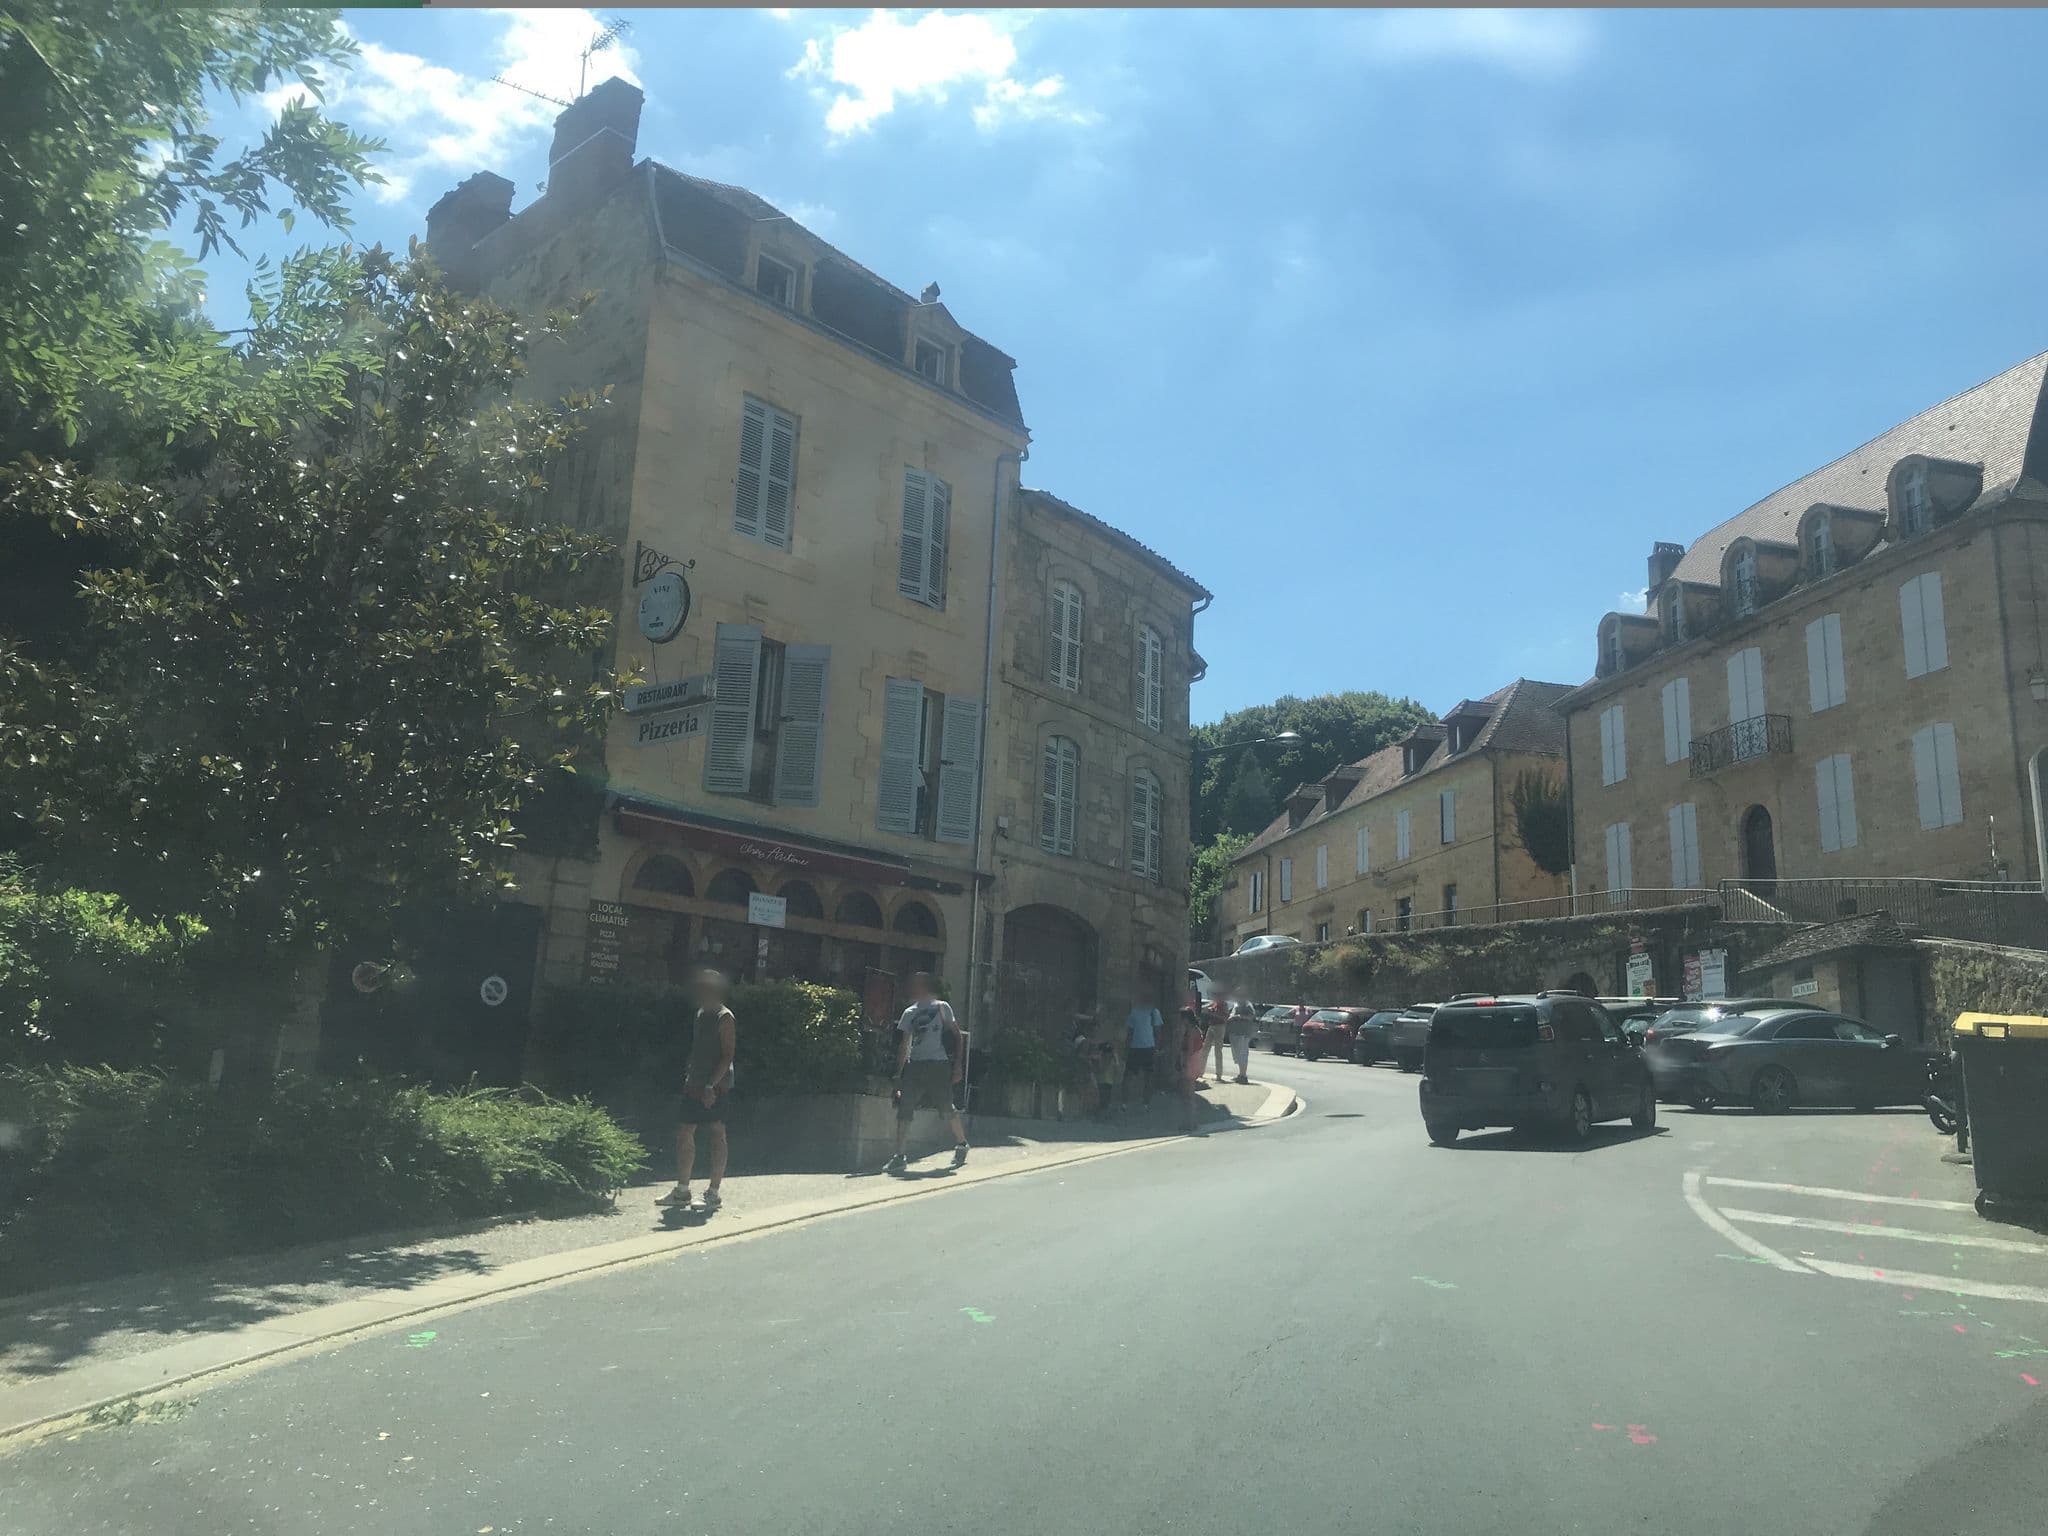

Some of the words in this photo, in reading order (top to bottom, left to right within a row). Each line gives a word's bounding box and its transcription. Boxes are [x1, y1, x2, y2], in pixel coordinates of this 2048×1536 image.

[637, 682, 689, 705] RESTAURANT
[638, 713, 699, 743] Pizzeria
[598, 903, 624, 915] LOCAL
